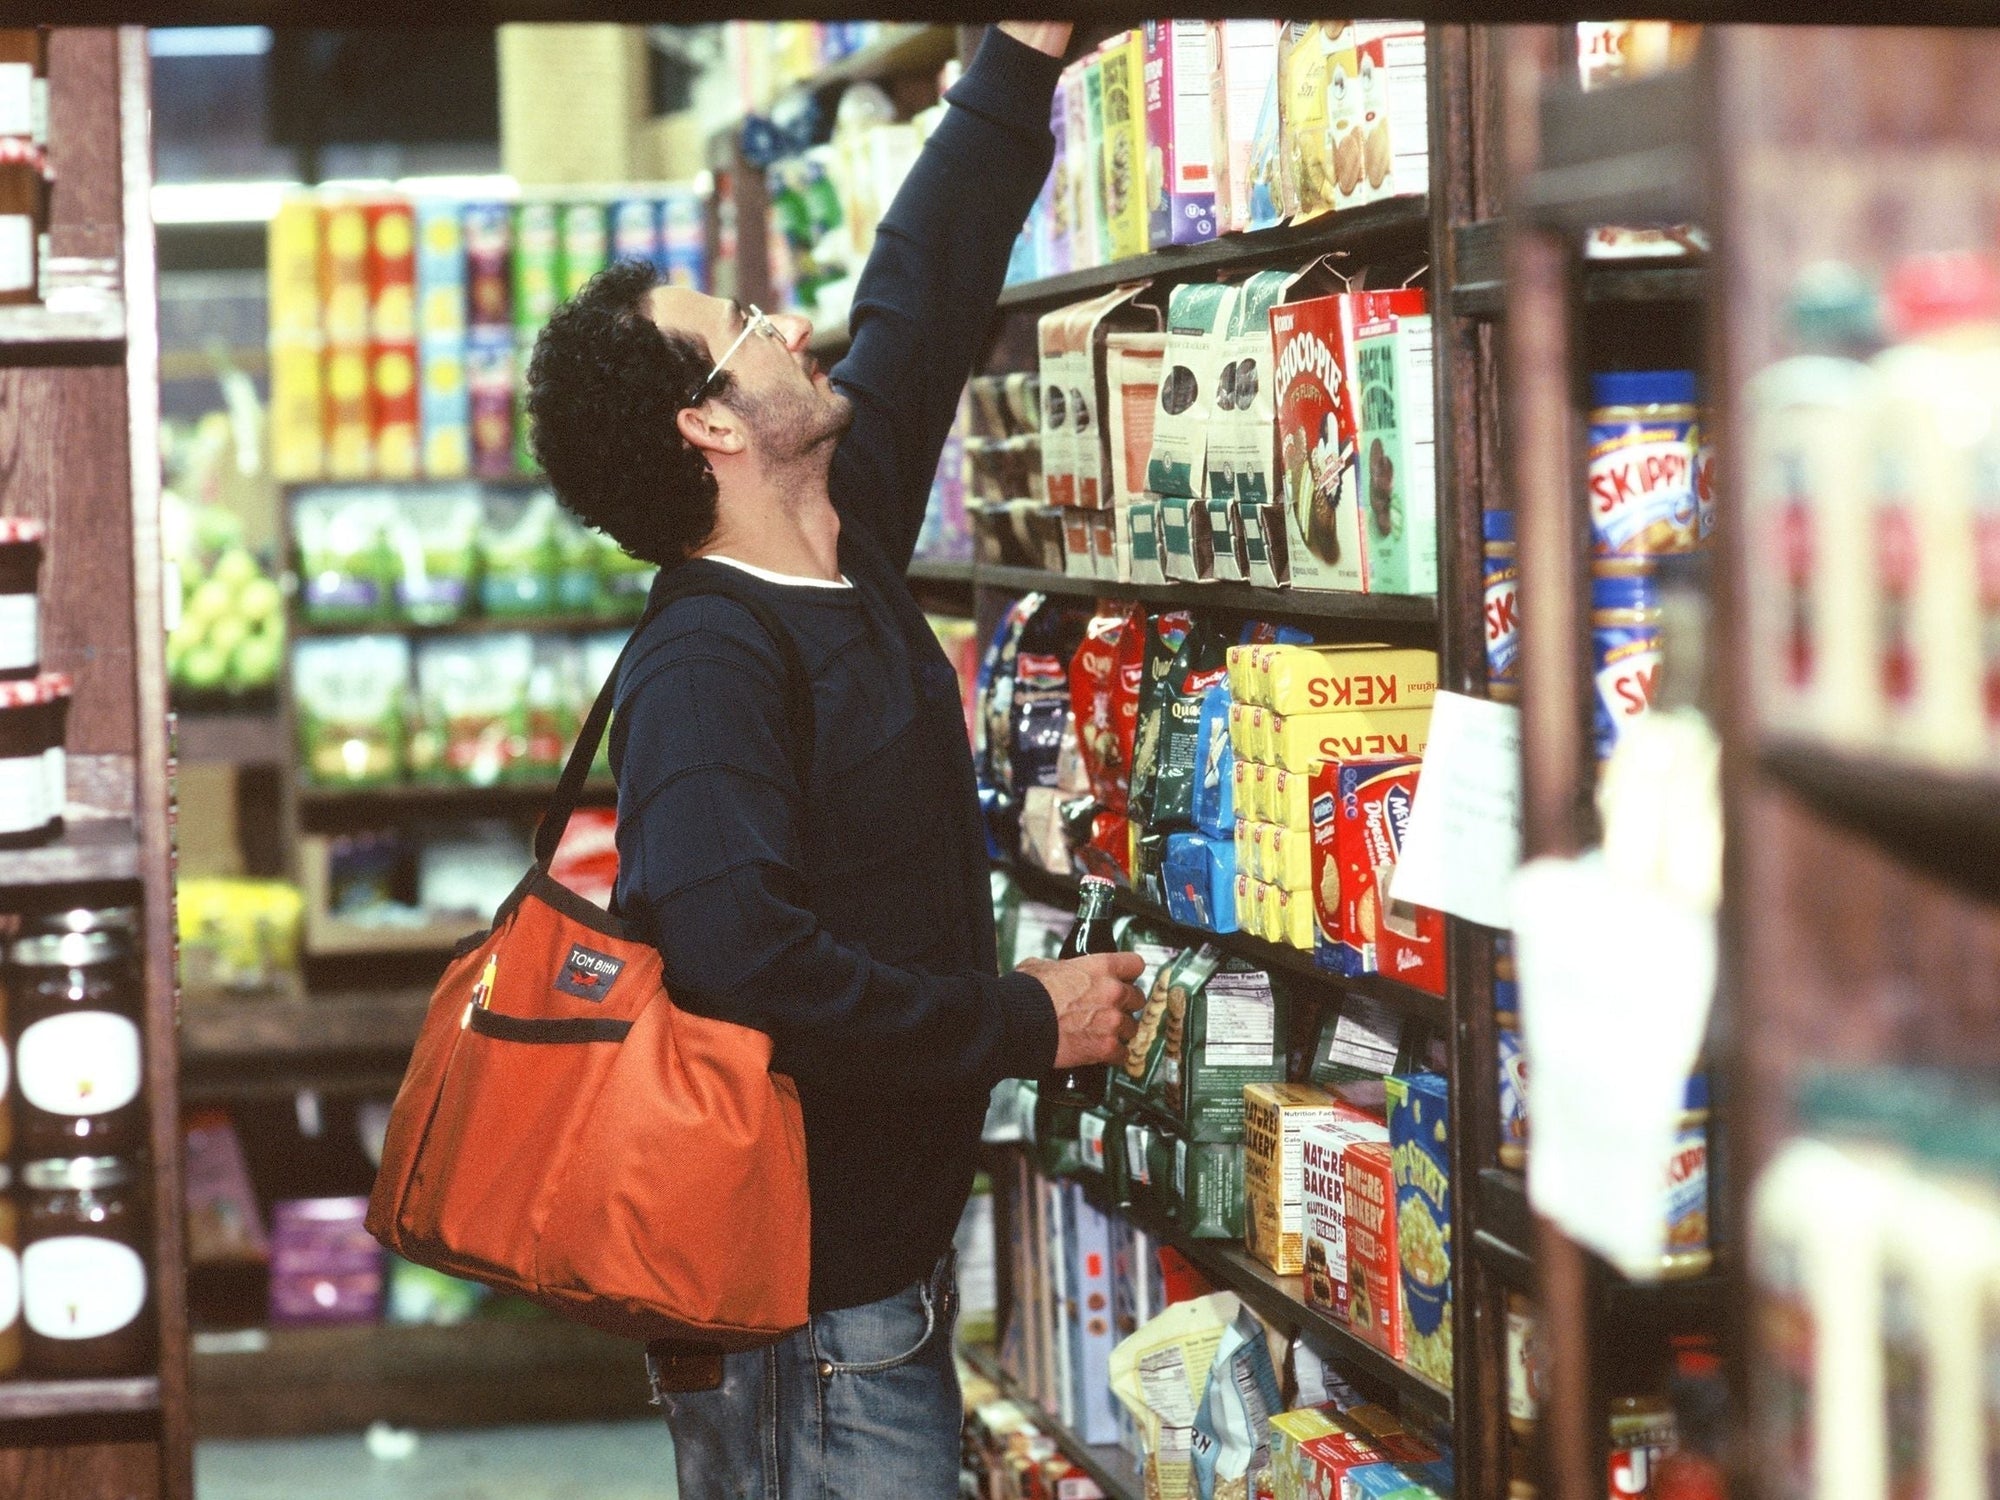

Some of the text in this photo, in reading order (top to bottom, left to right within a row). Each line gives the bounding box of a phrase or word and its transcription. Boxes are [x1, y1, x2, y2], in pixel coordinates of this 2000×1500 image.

[1307, 674, 1397, 707] KEKS
[571, 950, 618, 976] TOM BIHN
[1303, 1167, 1345, 1206] BAKER
[1306, 1201, 1346, 1230] GLUTEN FREE
[1345, 1190, 1386, 1235] BAKERY
